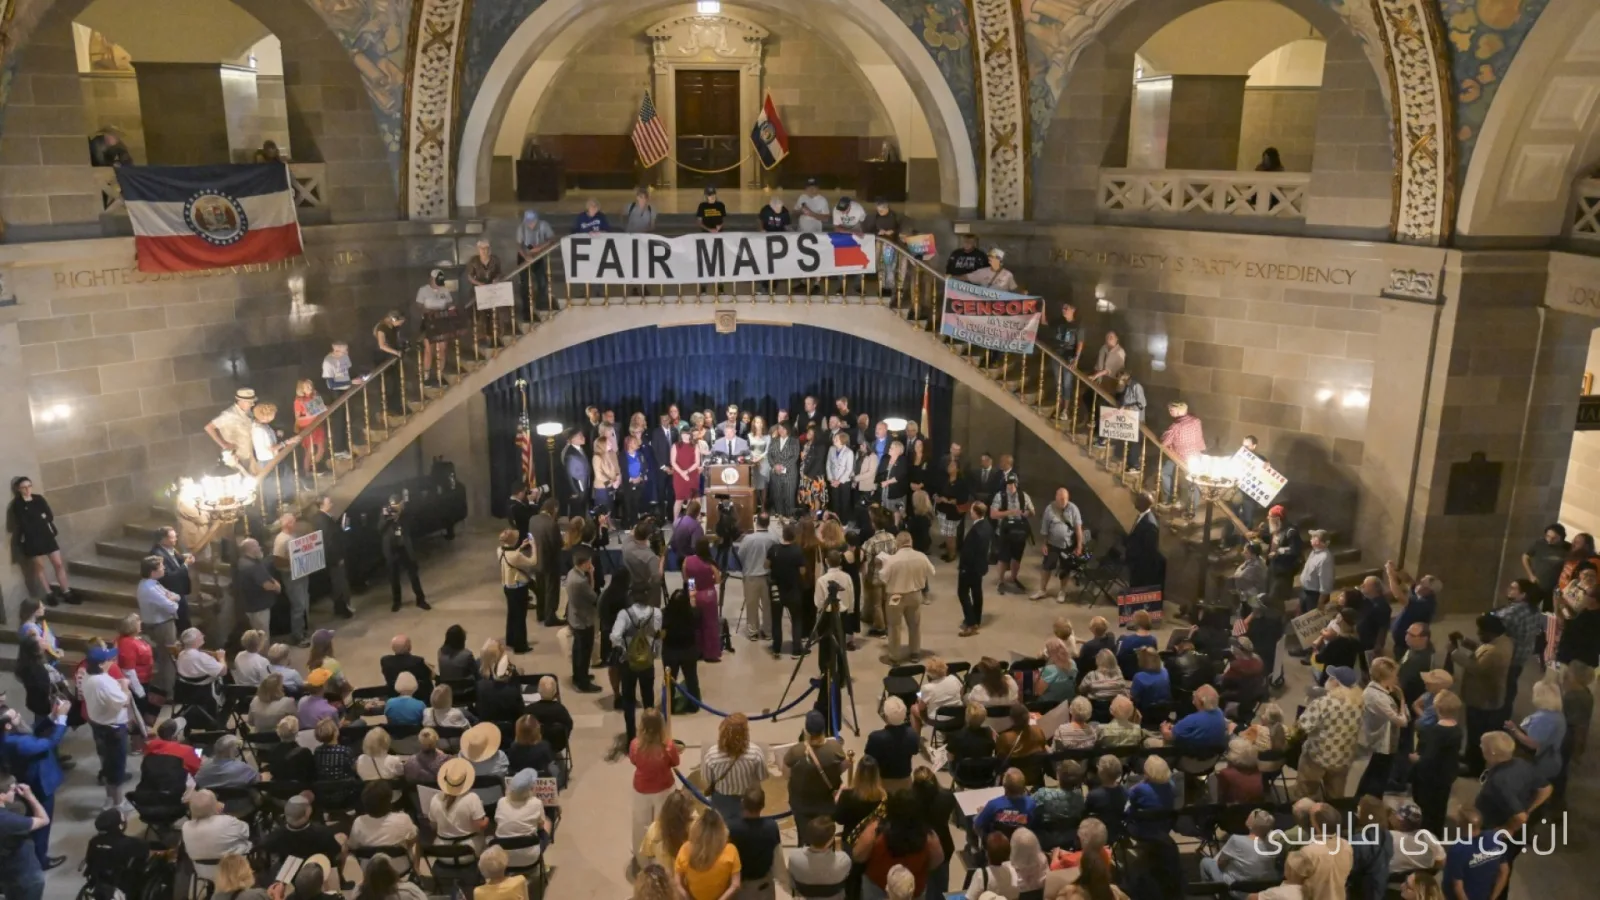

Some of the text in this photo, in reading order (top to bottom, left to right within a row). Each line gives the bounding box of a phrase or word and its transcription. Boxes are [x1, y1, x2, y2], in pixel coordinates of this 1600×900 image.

[570, 232, 821, 279] FAIR MAPS
[1096, 251, 1168, 270] HONESTY
[1191, 257, 1242, 276] PARTY
[1244, 261, 1357, 286] EXPEDIENCY
[982, 289, 1001, 300] NOT
[951, 300, 1038, 316] CENSOR
[952, 327, 1027, 351] IGNORANCE
[1104, 420, 1134, 430] DICTATOR
[1116, 415, 1126, 423] NO
[1103, 429, 1135, 439] MISSOURI
